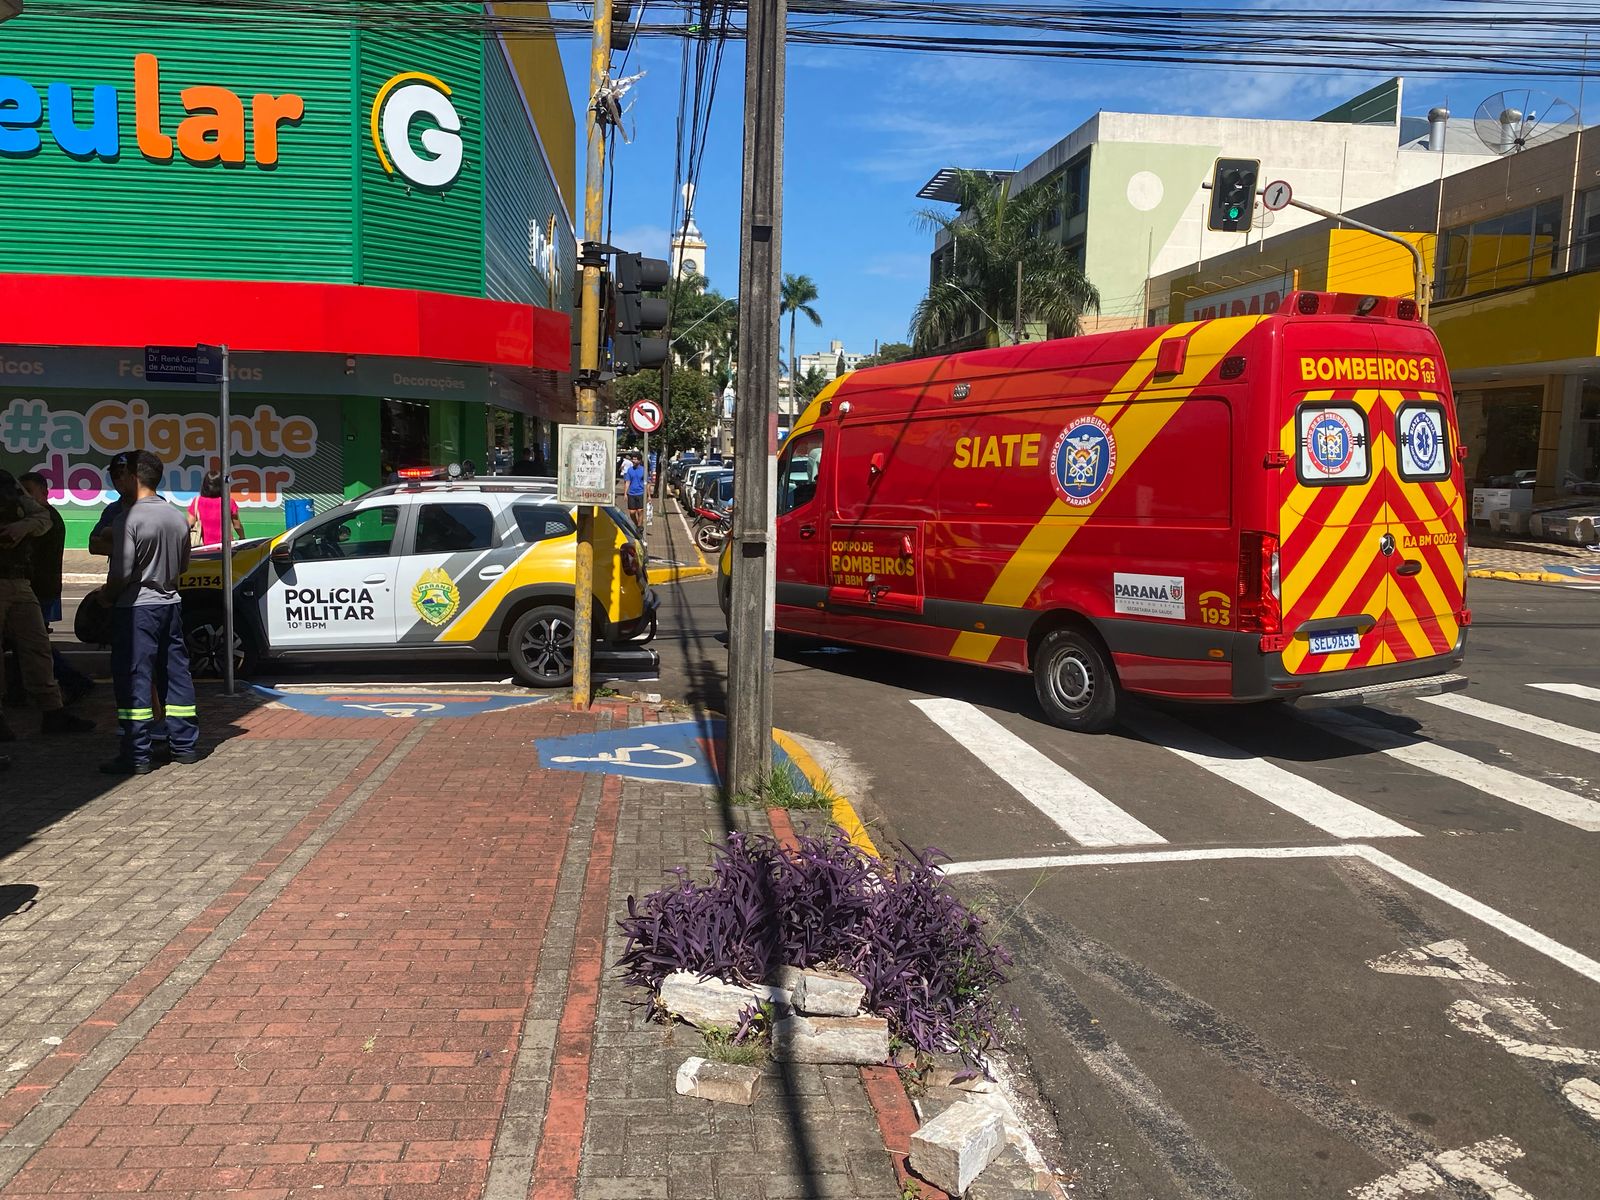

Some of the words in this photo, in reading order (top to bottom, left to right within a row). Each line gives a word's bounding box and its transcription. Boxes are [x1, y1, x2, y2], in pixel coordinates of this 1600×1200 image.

[134, 53, 304, 164] lar
[383, 85, 463, 186] G
[160, 363, 195, 373] Azambuja
[1301, 357, 1419, 381] BOMBEIROS
[393, 372, 465, 391] Decorações
[1422, 371, 1436, 384] 193
[953, 433, 1041, 469] SIATE
[1050, 442, 1060, 475] CORPO
[1060, 428, 1069, 440] DE
[1070, 416, 1110, 434] BOMBEIROS
[1108, 434, 1117, 475] MILITAR
[831, 541, 860, 552] CORPO
[862, 541, 874, 553] DE
[1404, 536, 1417, 547] AA
[1419, 535, 1432, 546] BM
[1433, 533, 1457, 545] 00022
[831, 555, 915, 576] BOMBEIROS
[845, 575, 863, 586] BBM
[1115, 583, 1168, 600] PARANÁ
[286, 605, 375, 621] MILITAR
[1201, 607, 1230, 626] 193
[1314, 634, 1355, 651] SEL9A53
